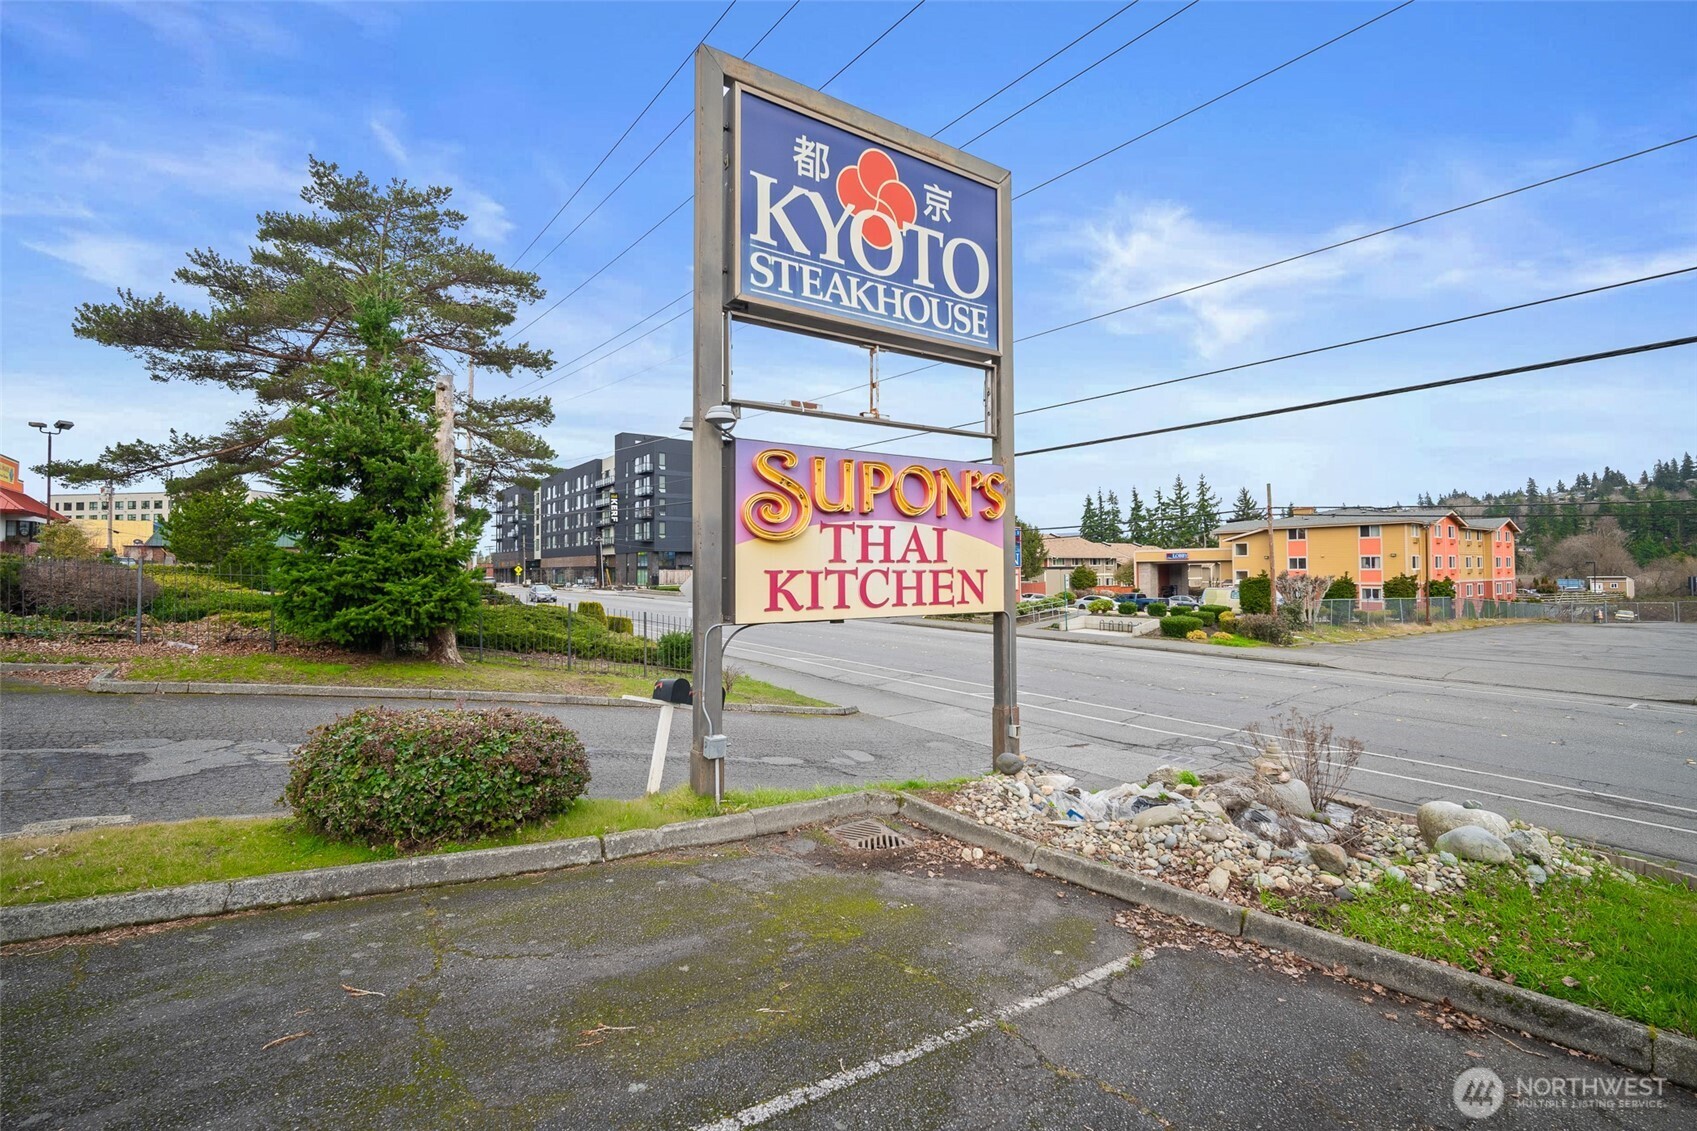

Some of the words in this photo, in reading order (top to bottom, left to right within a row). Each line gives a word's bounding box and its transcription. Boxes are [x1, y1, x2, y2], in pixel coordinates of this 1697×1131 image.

[793, 135, 830, 182] 都
[923, 184, 952, 223] 京
[750, 170, 990, 299] KYOTO
[750, 252, 989, 337] STEAKHOUSE
[740, 448, 1007, 541] SUPON'S
[819, 521, 948, 564] THAI
[763, 566, 988, 612] KITCHEN
